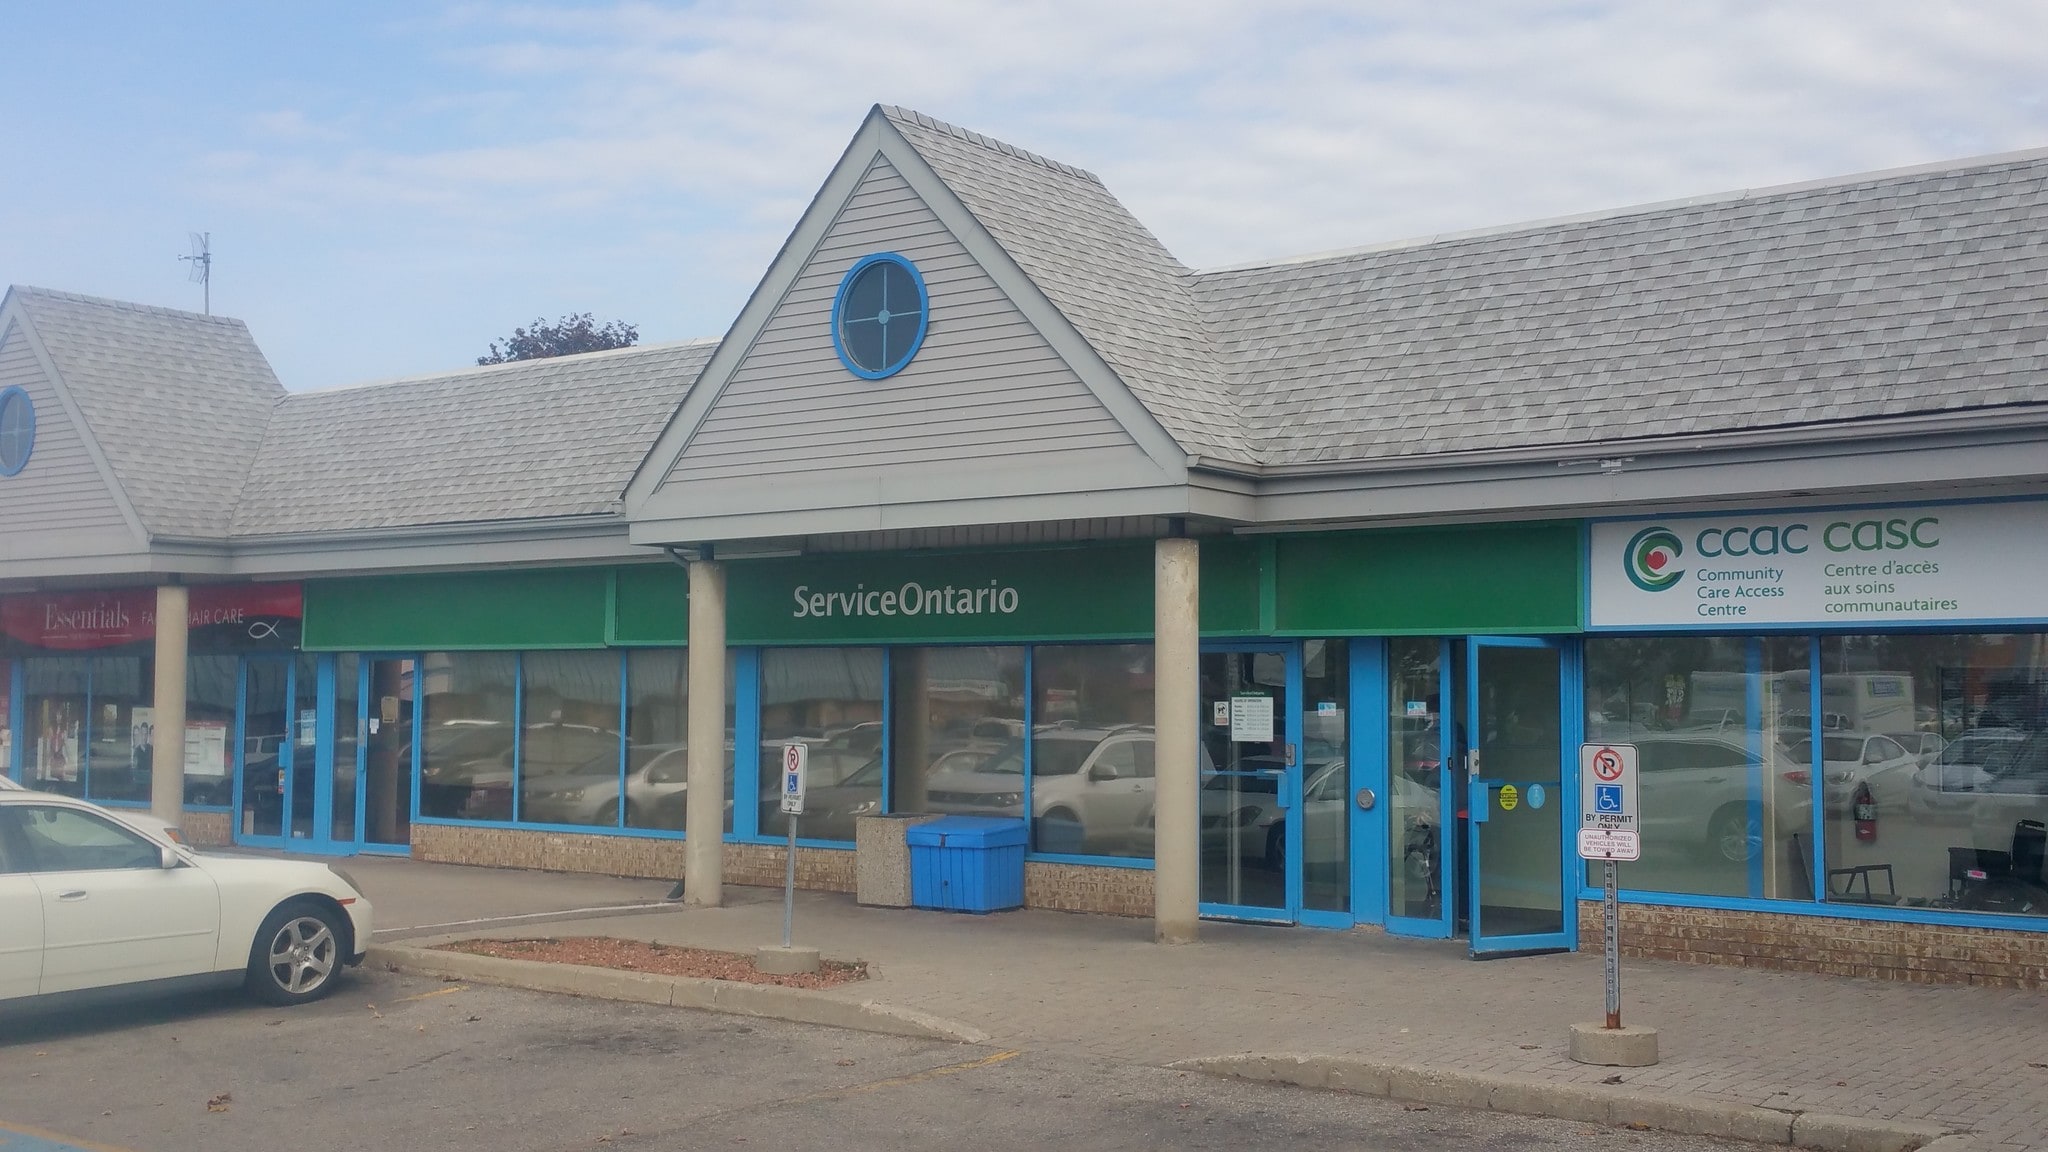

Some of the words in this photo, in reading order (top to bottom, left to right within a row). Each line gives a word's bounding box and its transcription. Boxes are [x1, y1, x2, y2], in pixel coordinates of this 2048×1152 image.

[1695, 523, 1808, 558] ccac
[1823, 516, 1940, 552] casc
[1696, 566, 1784, 583] Community
[1824, 562, 1877, 577] Centre
[1882, 559, 1940, 576] d'accès
[1696, 585, 1731, 599] Care
[1734, 584, 1784, 598] Access
[1824, 583, 1851, 596] aux
[1855, 580, 1896, 595] soins
[793, 579, 1019, 618] ServiceOntario
[1824, 597, 1958, 613] communautaires
[44, 601, 130, 631] Essentials
[214, 608, 244, 624] CARE
[1697, 603, 1747, 617] Centre
[1585, 813, 1596, 822] BY
[1599, 814, 1634, 824] PERMIT
[1584, 834, 1632, 842] UNAUTHORIZED
